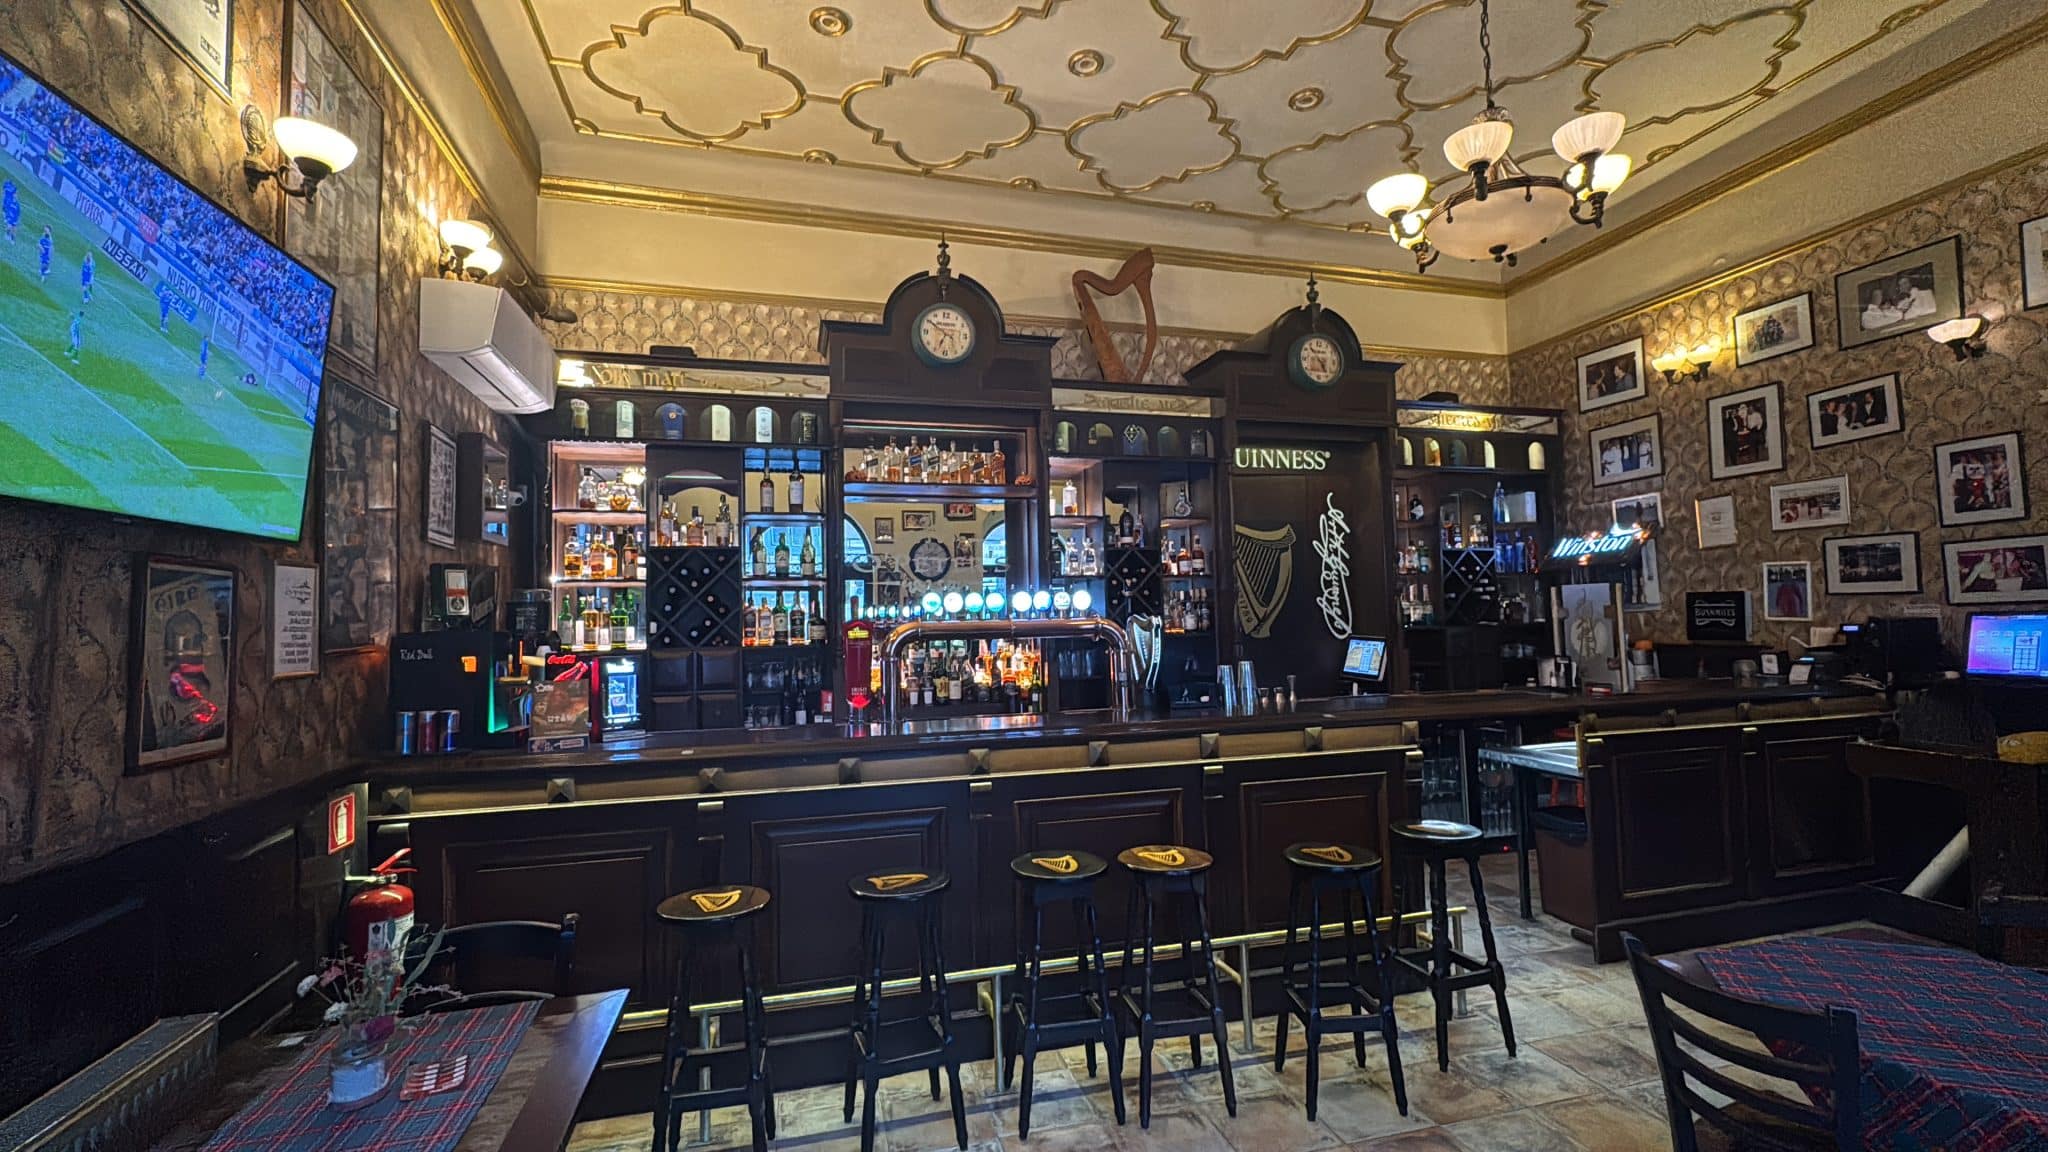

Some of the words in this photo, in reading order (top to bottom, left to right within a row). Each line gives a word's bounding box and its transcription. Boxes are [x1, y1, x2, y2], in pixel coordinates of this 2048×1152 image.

[104, 239, 147, 281] NISSAN
[167, 266, 197, 300] NUEVO
[1552, 535, 1632, 558] Winston
